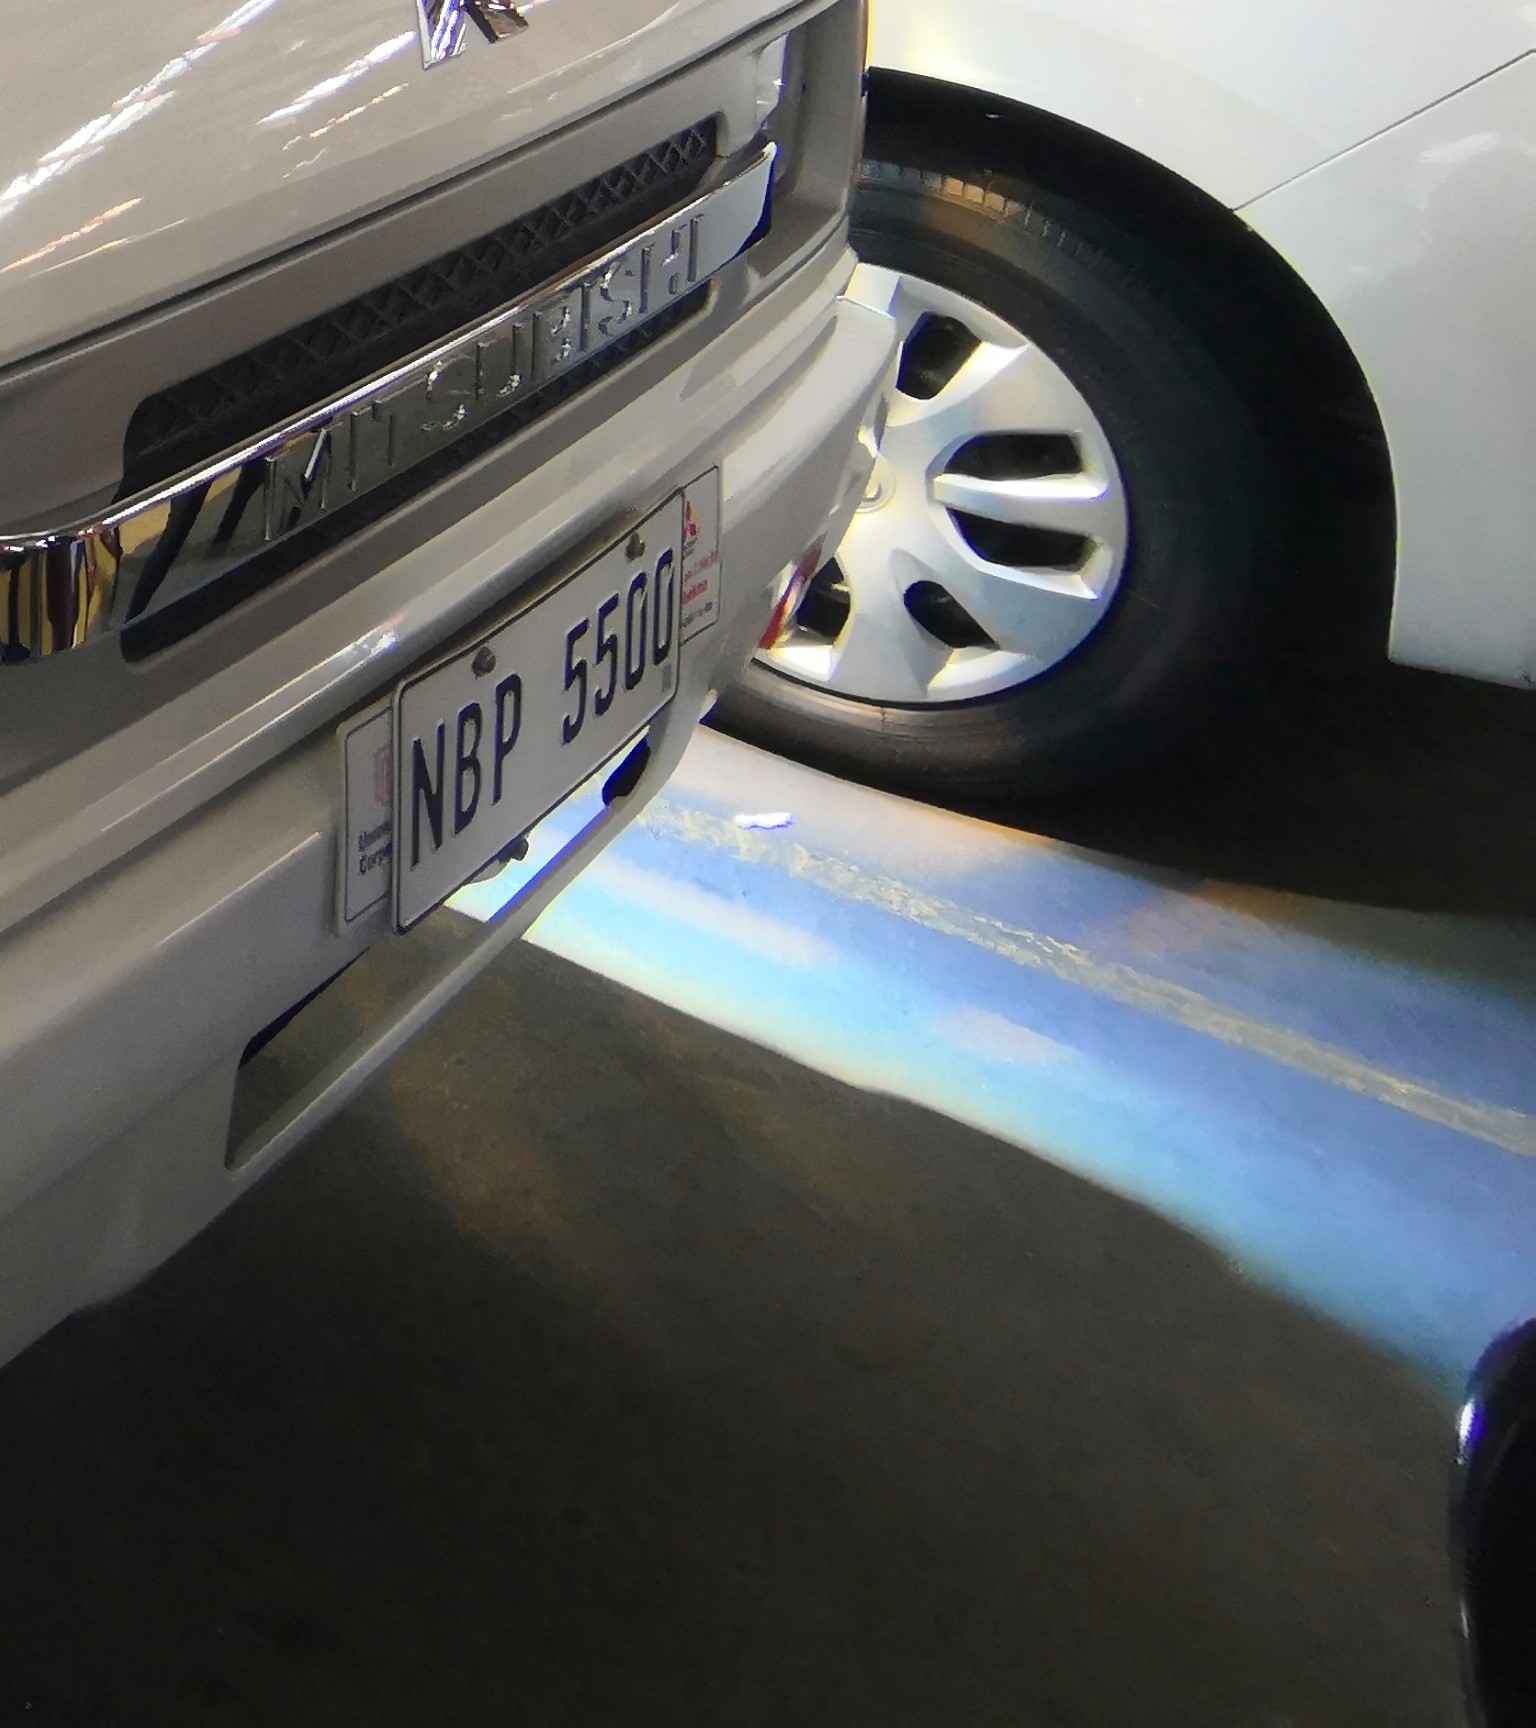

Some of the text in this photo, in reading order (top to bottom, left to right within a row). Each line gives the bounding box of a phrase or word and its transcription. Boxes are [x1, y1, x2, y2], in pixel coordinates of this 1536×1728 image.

[262, 213, 706, 542] MITSUBISHI
[410, 547, 675, 872] NBP 5500
